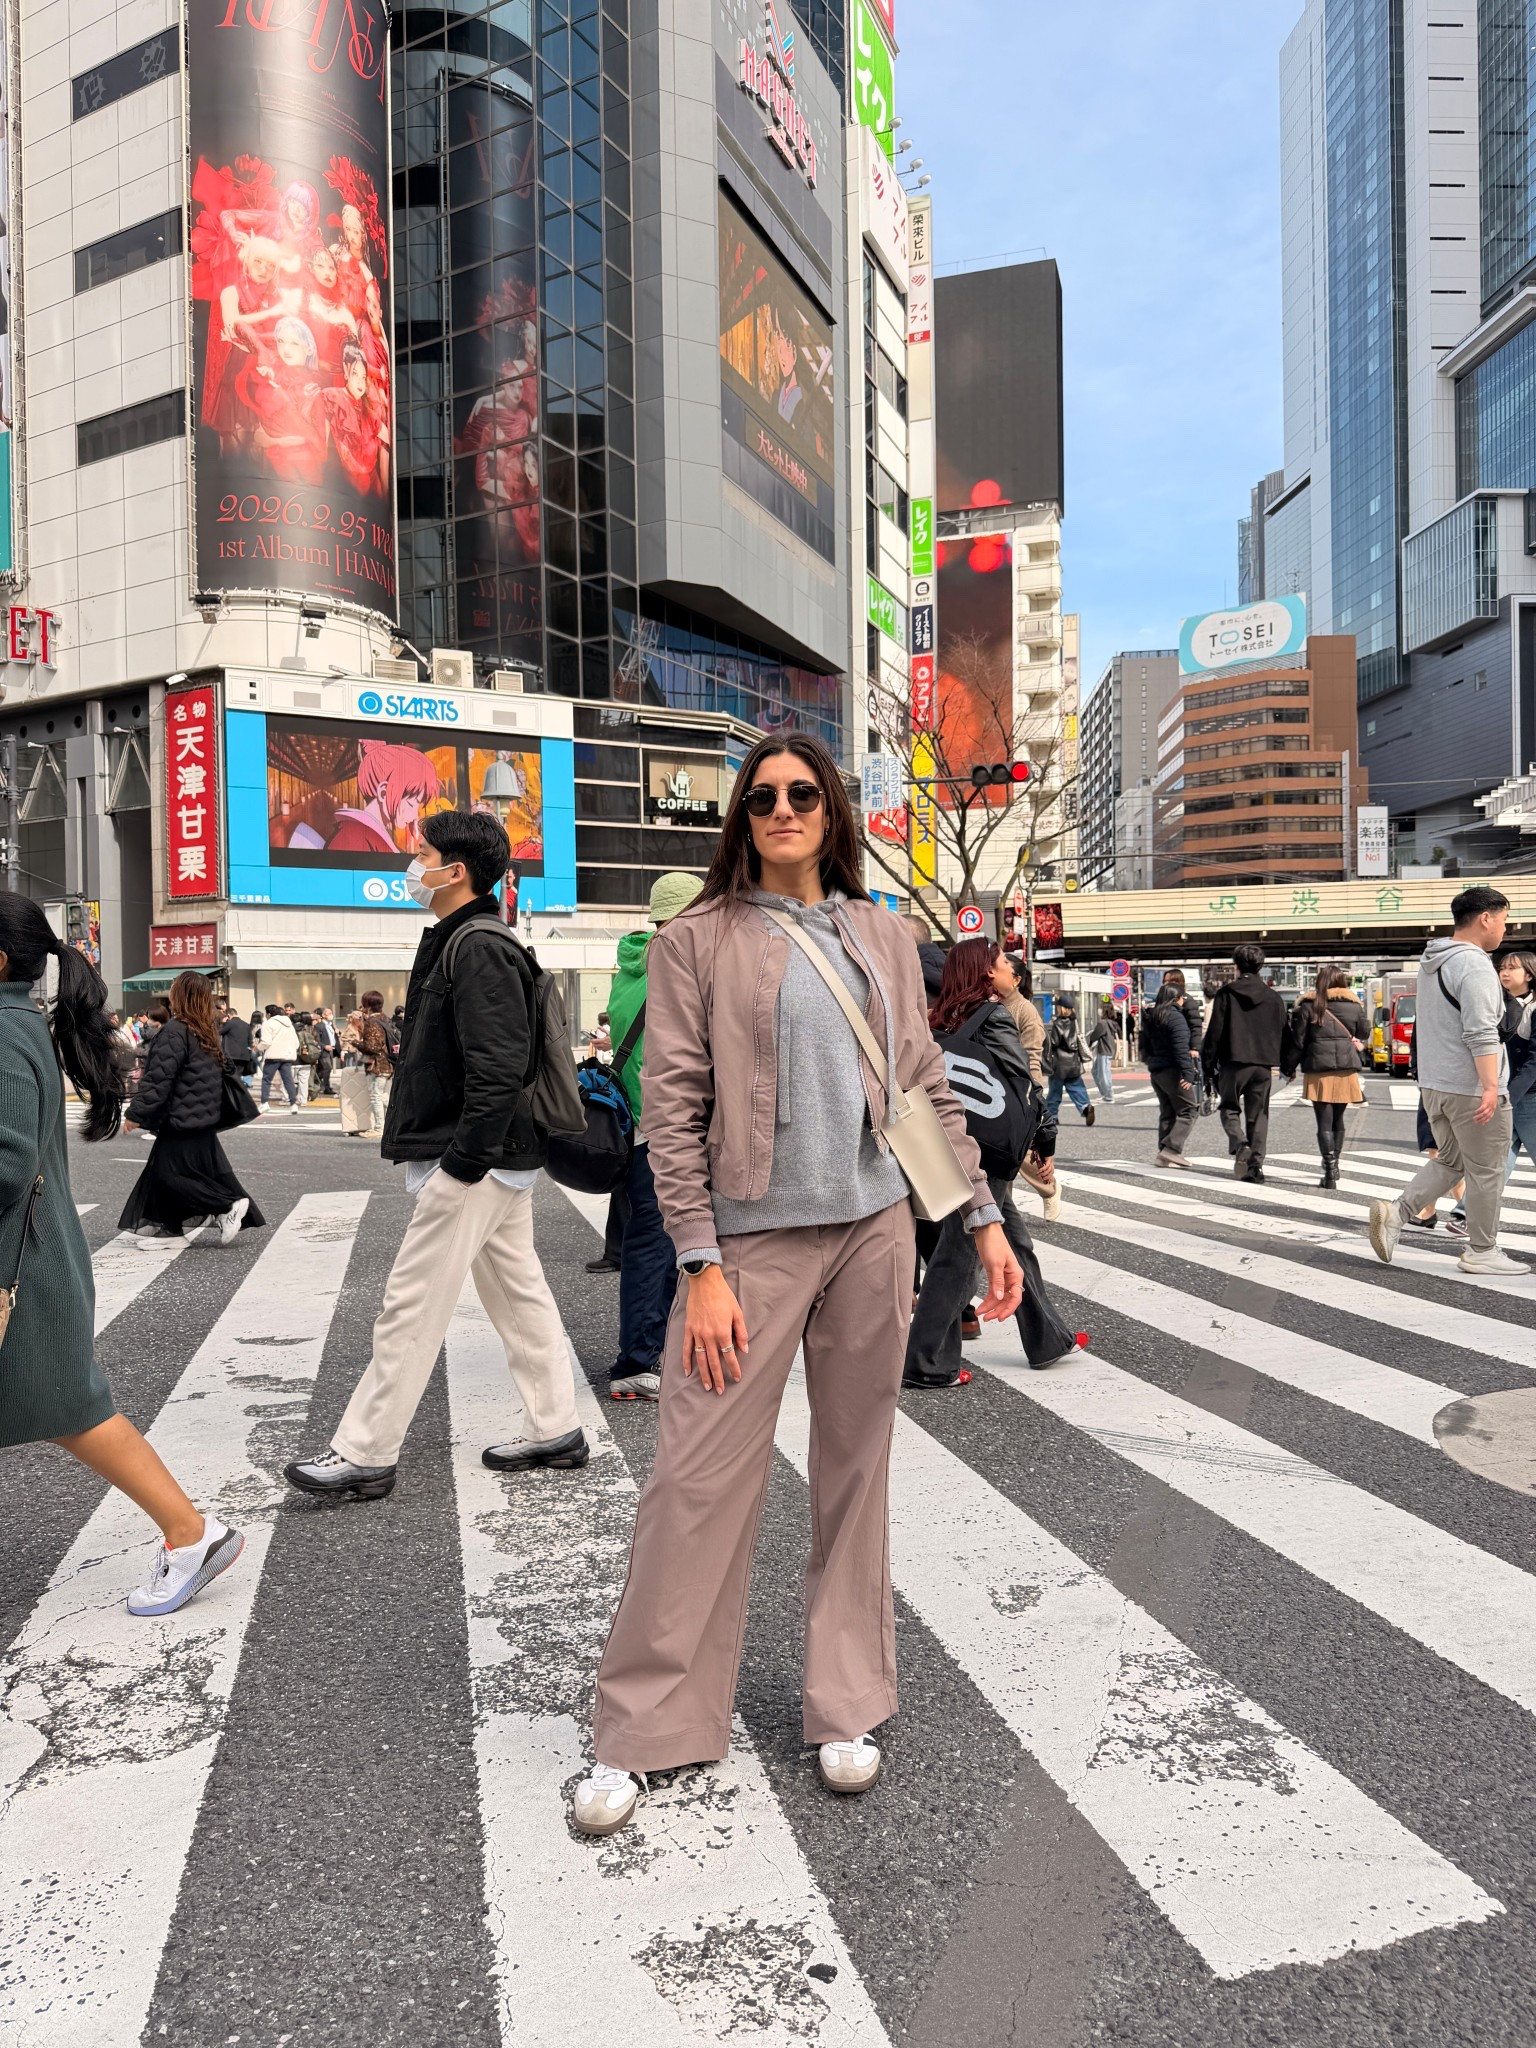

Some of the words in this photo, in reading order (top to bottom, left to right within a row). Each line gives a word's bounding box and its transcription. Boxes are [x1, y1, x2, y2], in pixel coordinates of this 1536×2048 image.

[856, 3, 887, 132] レイク
[743, 42, 818, 189] MAGNET
[215, 493, 368, 547] 2026.2.25
[915, 506, 928, 545] レイク
[219, 538, 246, 558] 1st
[251, 534, 330, 567] Album
[870, 585, 893, 623] レイク
[1209, 622, 1273, 648] TOSEI
[1209, 639, 1273, 659] トーセイ株式会社
[174, 701, 207, 722] 名物
[871, 758, 882, 807] 渋谷駅前
[890, 759, 899, 807] スクランブル式
[176, 725, 207, 882] 天津甘栗
[657, 798, 708, 812] COFFEE
[1209, 895, 1237, 911] JR
[154, 934, 214, 956] 天津甘栗
